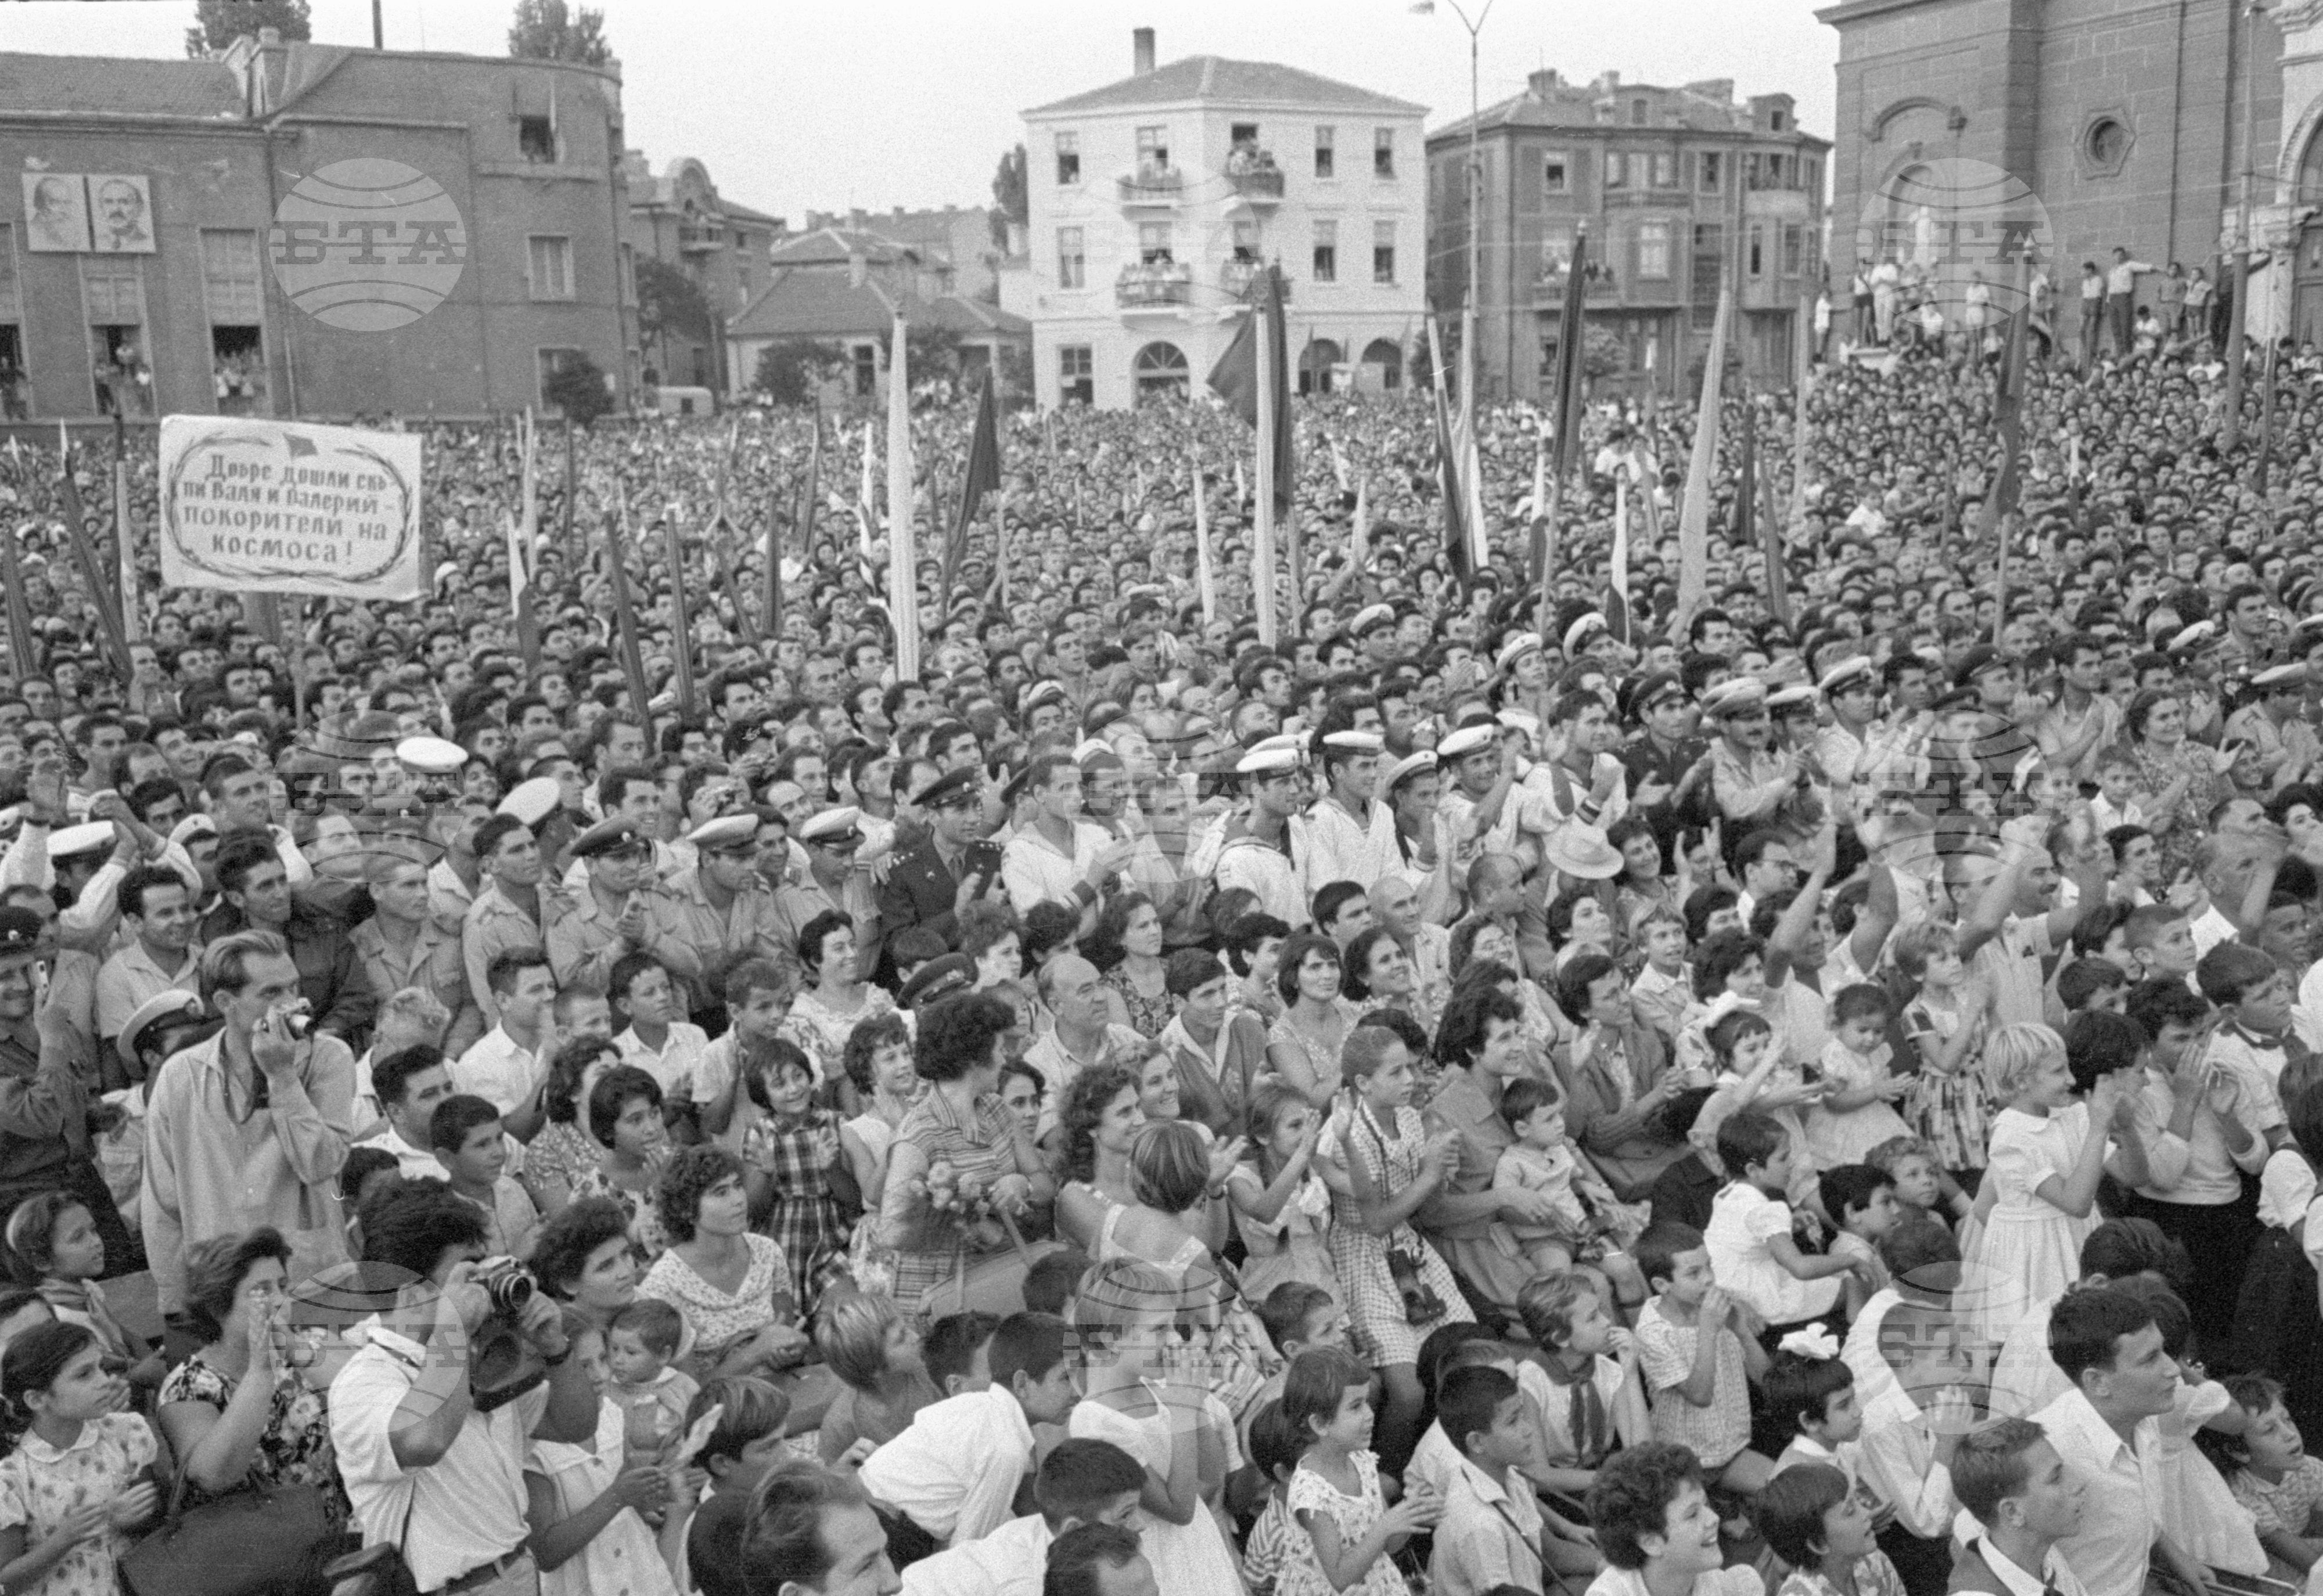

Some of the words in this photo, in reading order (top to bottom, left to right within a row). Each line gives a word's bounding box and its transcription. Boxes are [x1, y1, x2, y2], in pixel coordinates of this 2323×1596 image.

[280, 465, 349, 489] дошли
[184, 481, 206, 499] пи
[267, 488, 280, 503] и
[287, 488, 379, 516] Валерий
[184, 505, 343, 536] покорители
[358, 523, 387, 541] на
